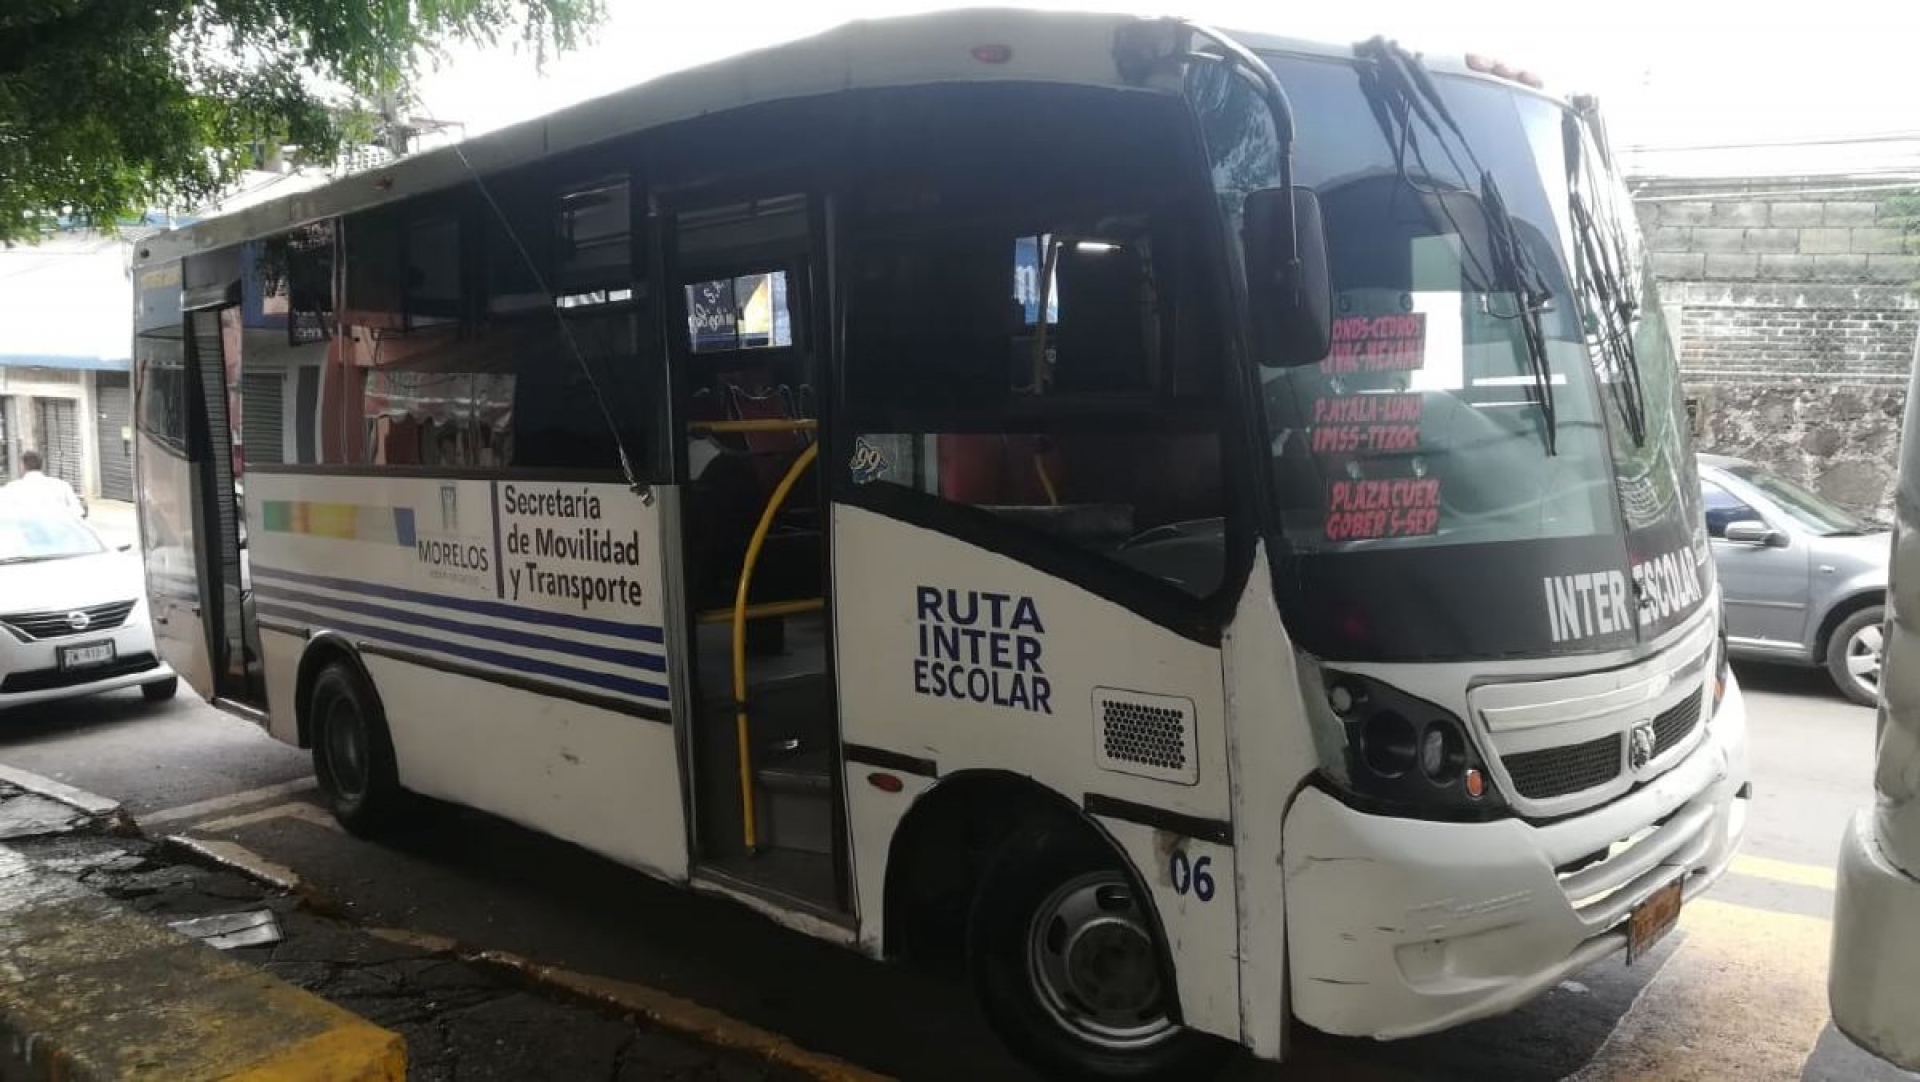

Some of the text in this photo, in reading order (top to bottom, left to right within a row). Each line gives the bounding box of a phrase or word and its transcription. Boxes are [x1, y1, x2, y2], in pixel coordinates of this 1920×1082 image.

[505, 484, 601, 519] Secretaría
[1331, 480, 1390, 511] PLAZA
[507, 522, 639, 566] de Movilidad
[1325, 510, 1386, 539] GOBER
[418, 539, 489, 571] MORELOS
[510, 562, 642, 609] y Transporte
[1544, 546, 1703, 642] INTER ESCOLAR
[917, 585, 1046, 634] RUTA
[919, 622, 1045, 674] INTER
[914, 658, 1053, 715] ESCOLAR
[1170, 848, 1215, 902] 06
